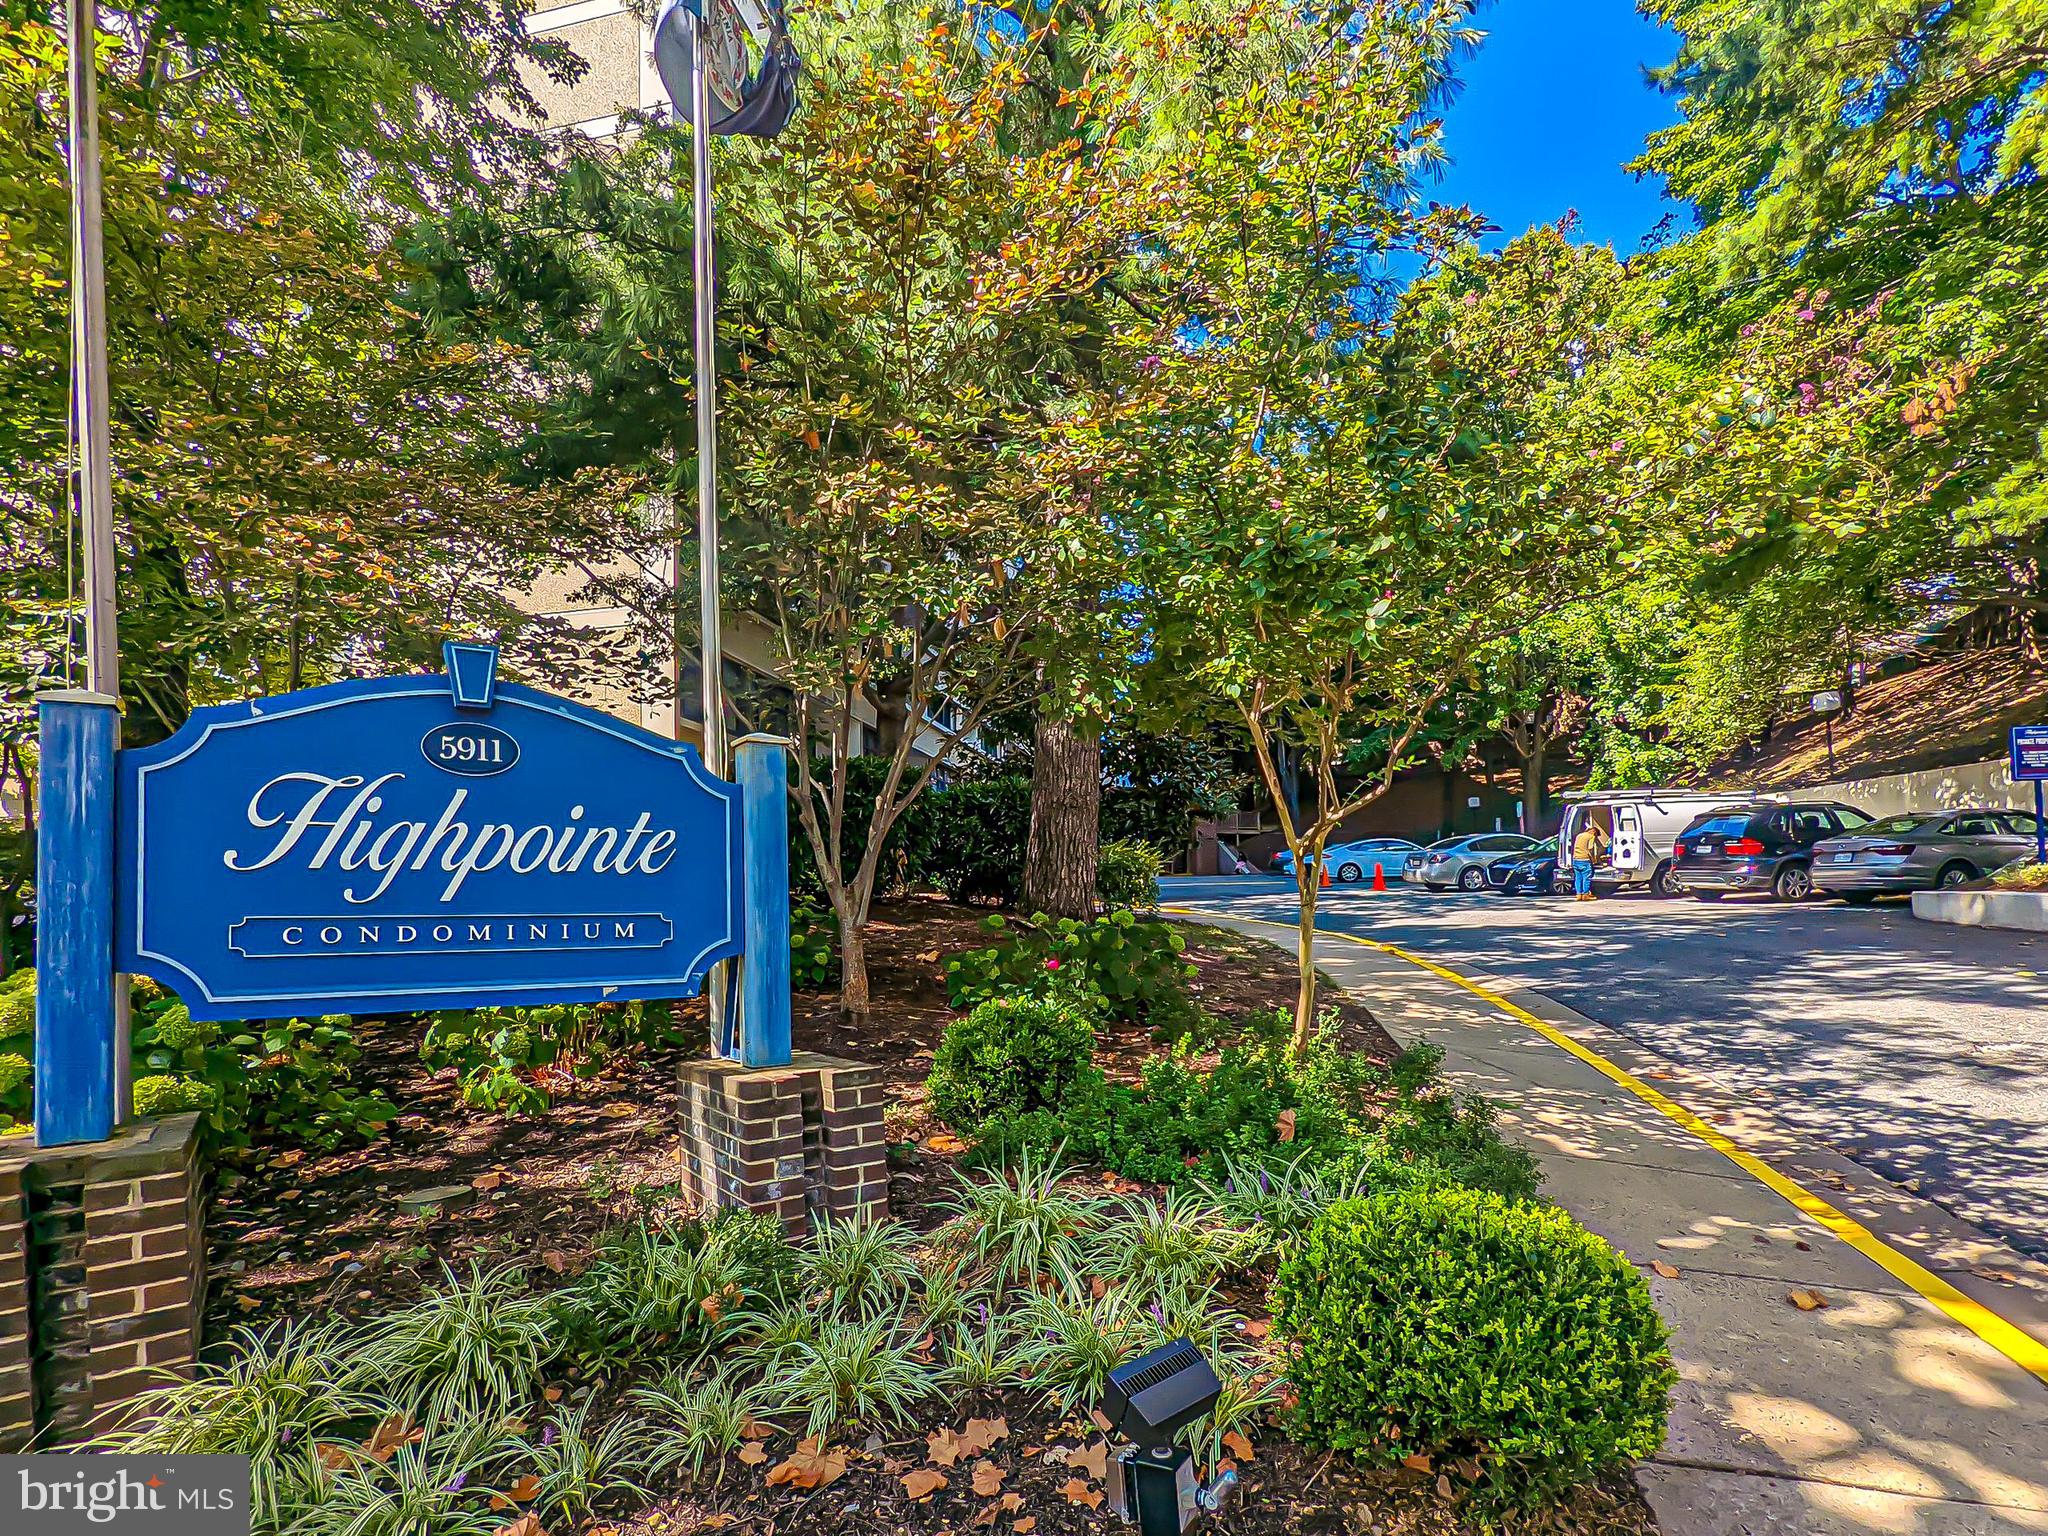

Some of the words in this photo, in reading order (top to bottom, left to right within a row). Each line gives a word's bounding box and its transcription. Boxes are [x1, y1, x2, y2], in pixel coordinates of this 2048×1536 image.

[438, 735, 504, 763] 5911
[223, 772, 677, 904] Highpointe
[281, 921, 638, 946] CONDOMINIUM
